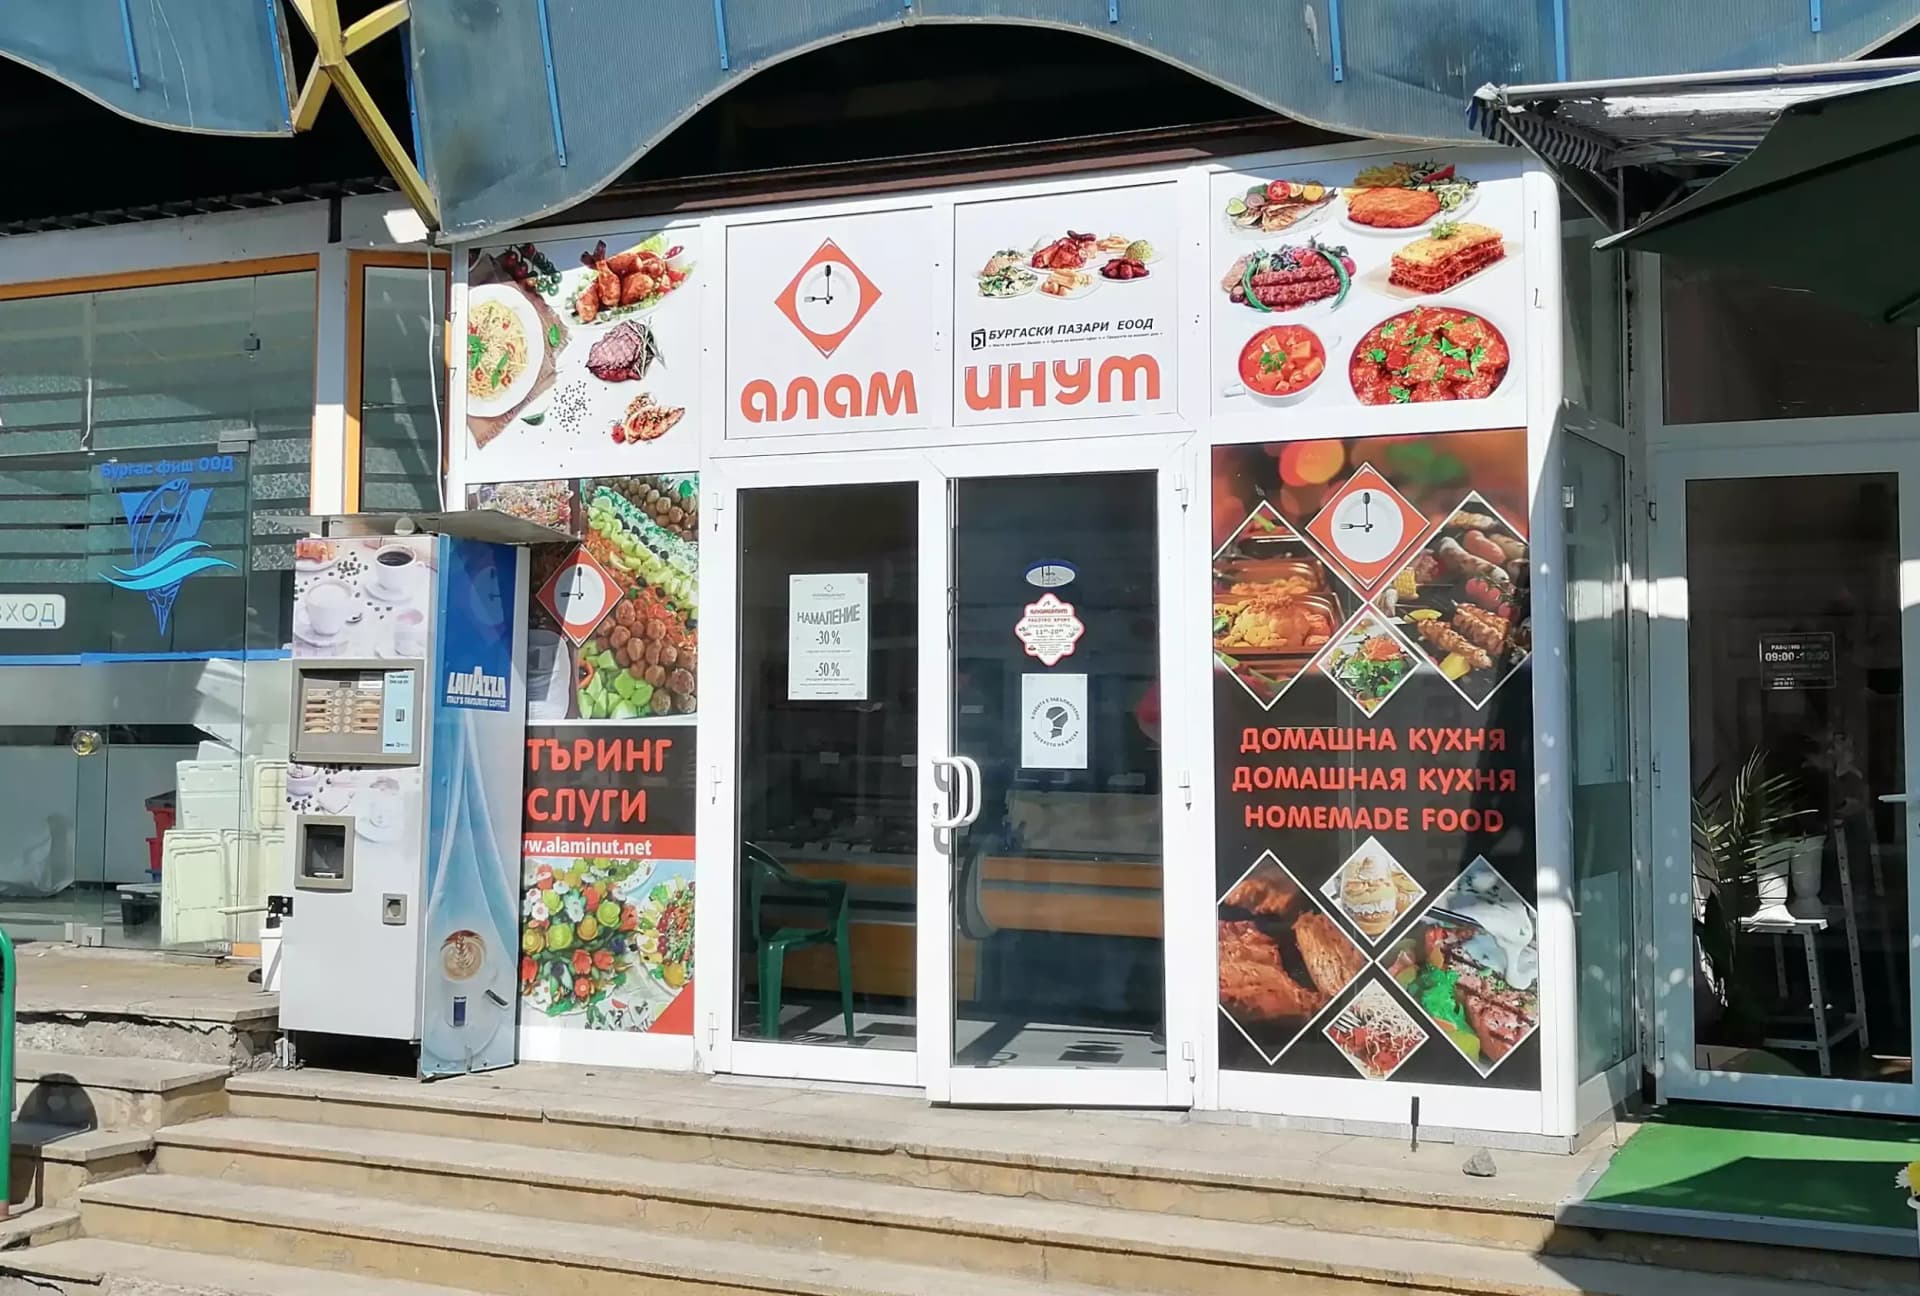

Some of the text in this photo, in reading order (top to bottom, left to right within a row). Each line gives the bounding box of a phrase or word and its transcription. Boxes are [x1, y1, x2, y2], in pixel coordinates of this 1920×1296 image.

[988, 325, 1054, 340] БУРГАСКИ
[1057, 321, 1110, 336] ПАЗАРИ
[1116, 318, 1154, 331] ЕООД
[199, 455, 234, 473] ООД
[0, 602, 57, 627] ХОД
[797, 603, 861, 625] НАМАЛЕНИЕ
[447, 666, 507, 698] LAVAZZA
[1240, 727, 1506, 755] ДОМАШНА КУХНЯ
[1232, 766, 1517, 796] ДОМАШНАЯ КУХНЯ
[1244, 805, 1505, 833] HOMEMADE FOOD
